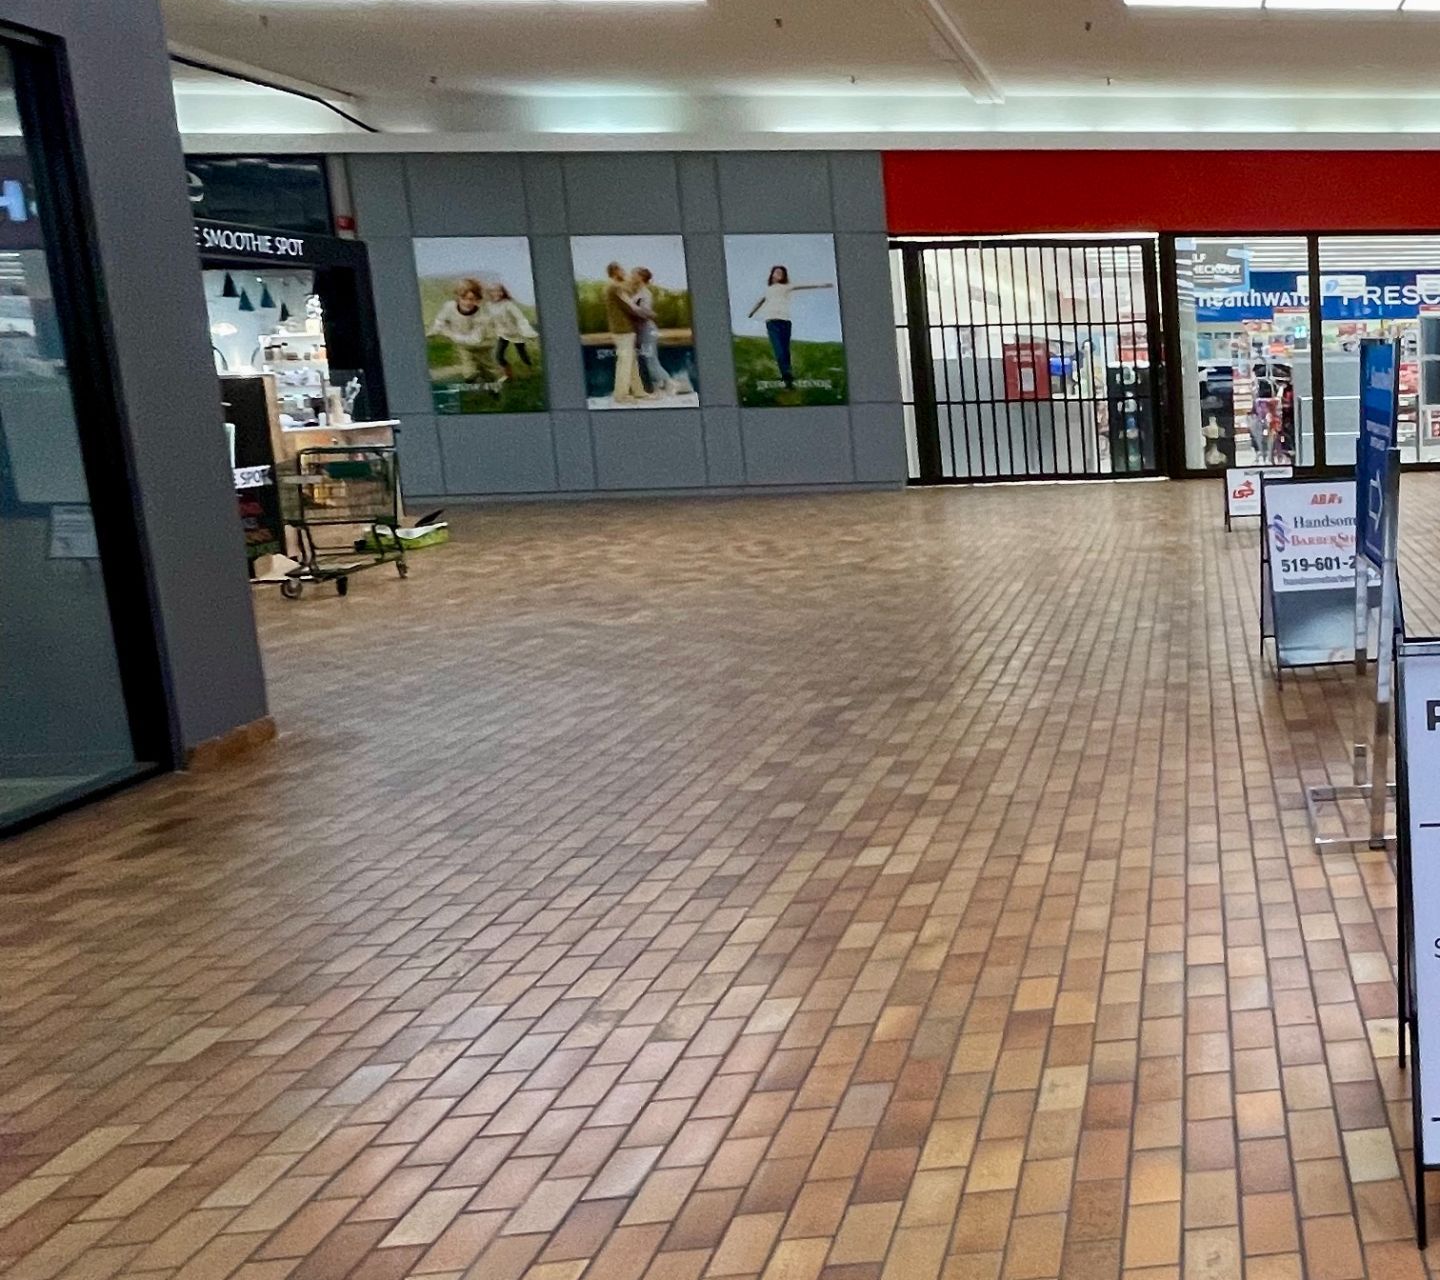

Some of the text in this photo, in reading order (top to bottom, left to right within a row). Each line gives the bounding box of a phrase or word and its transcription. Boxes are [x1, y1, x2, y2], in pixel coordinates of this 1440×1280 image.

[202, 227, 274, 255] SMOOTHIE
[274, 236, 305, 257] SPOT
[1281, 555, 1357, 573] 519-601-2
